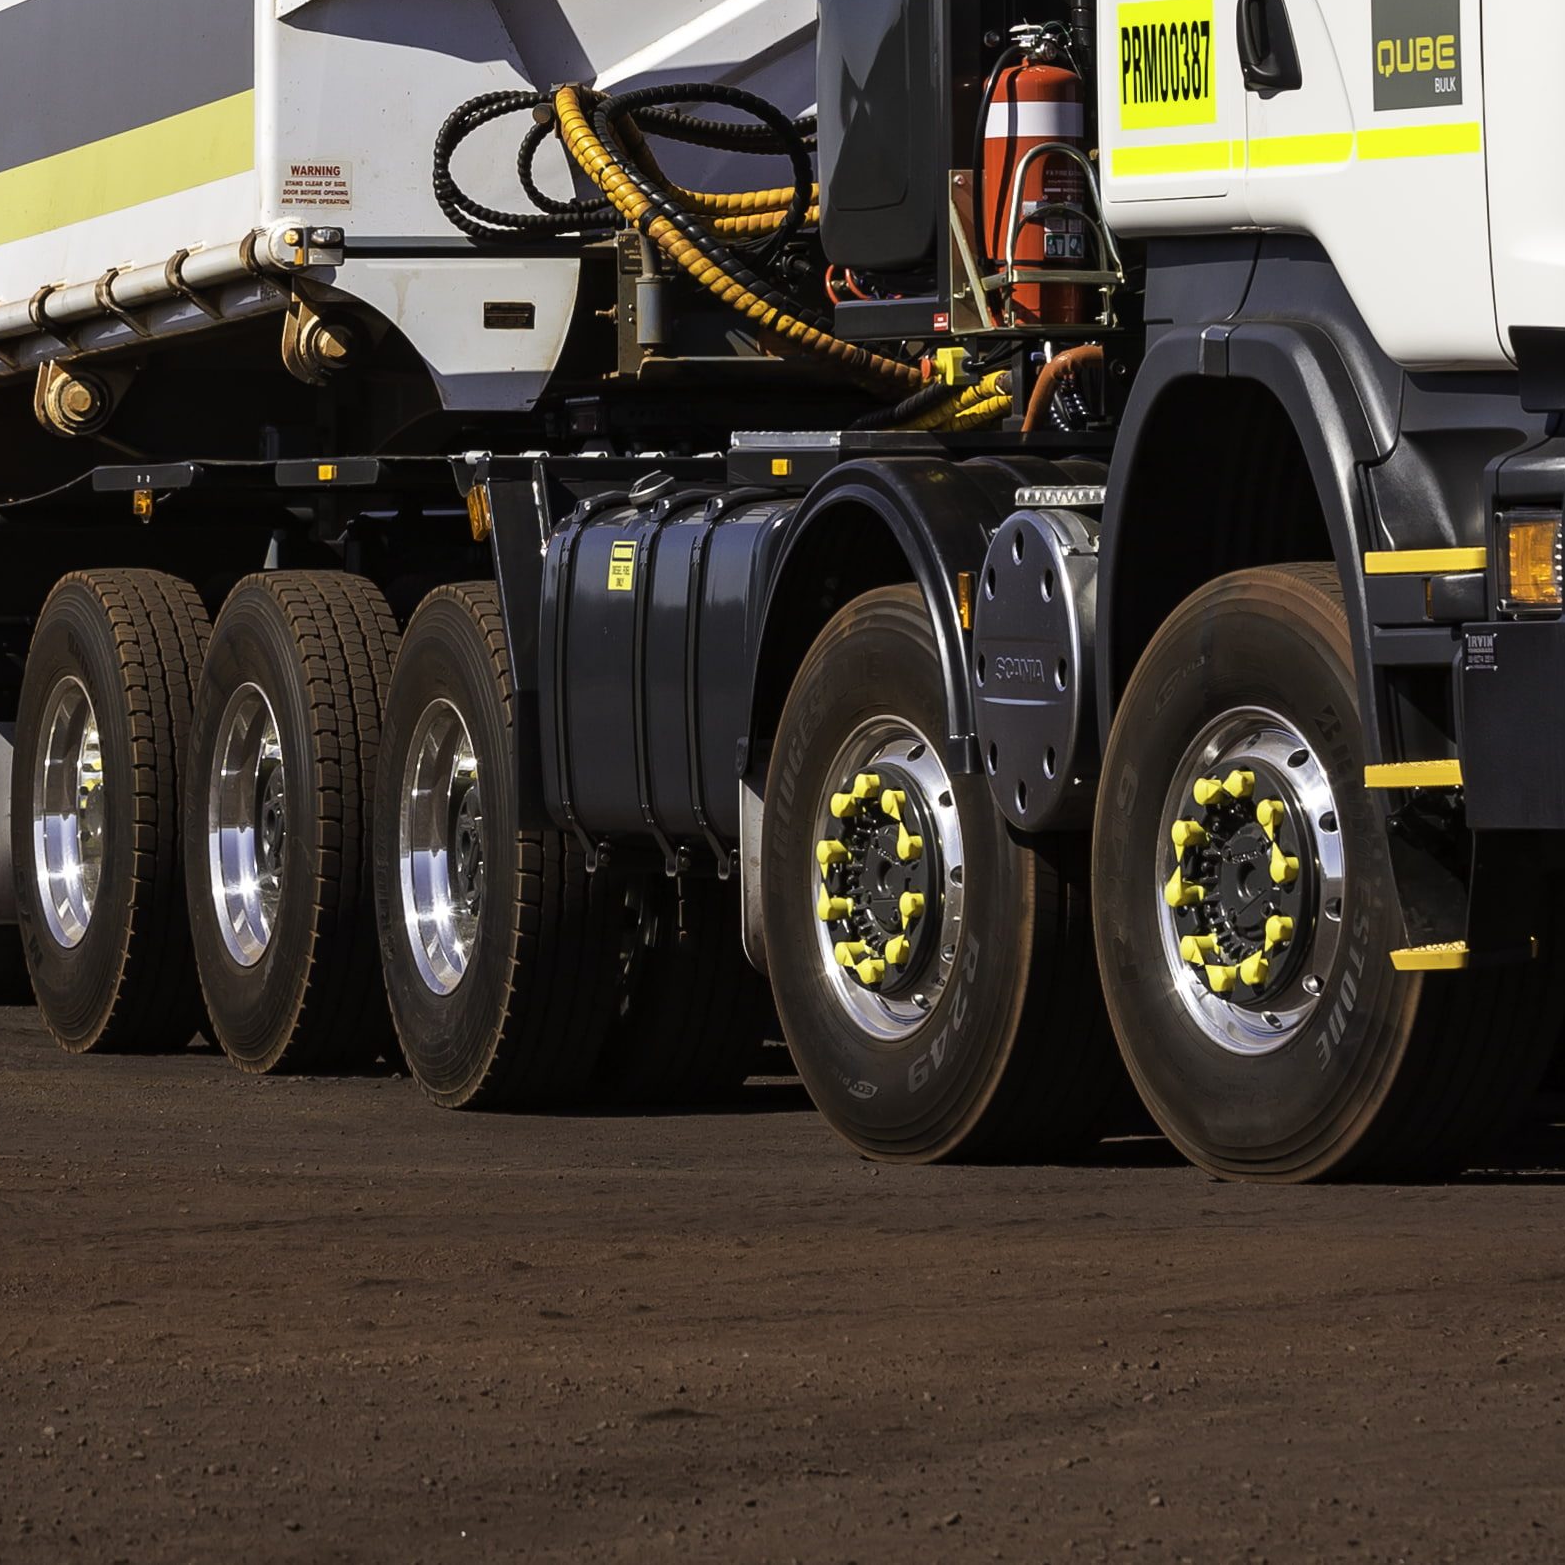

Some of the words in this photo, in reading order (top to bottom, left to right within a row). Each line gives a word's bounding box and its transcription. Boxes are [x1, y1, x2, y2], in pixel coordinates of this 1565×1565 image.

[1121, 20, 1210, 105] PRM00387
[1377, 35, 1455, 77] QUBE
[1434, 76, 1456, 93] BULK
[290, 165, 341, 176] WARNING
[995, 657, 1045, 683] SCANIA
[907, 932, 980, 1095] R249
